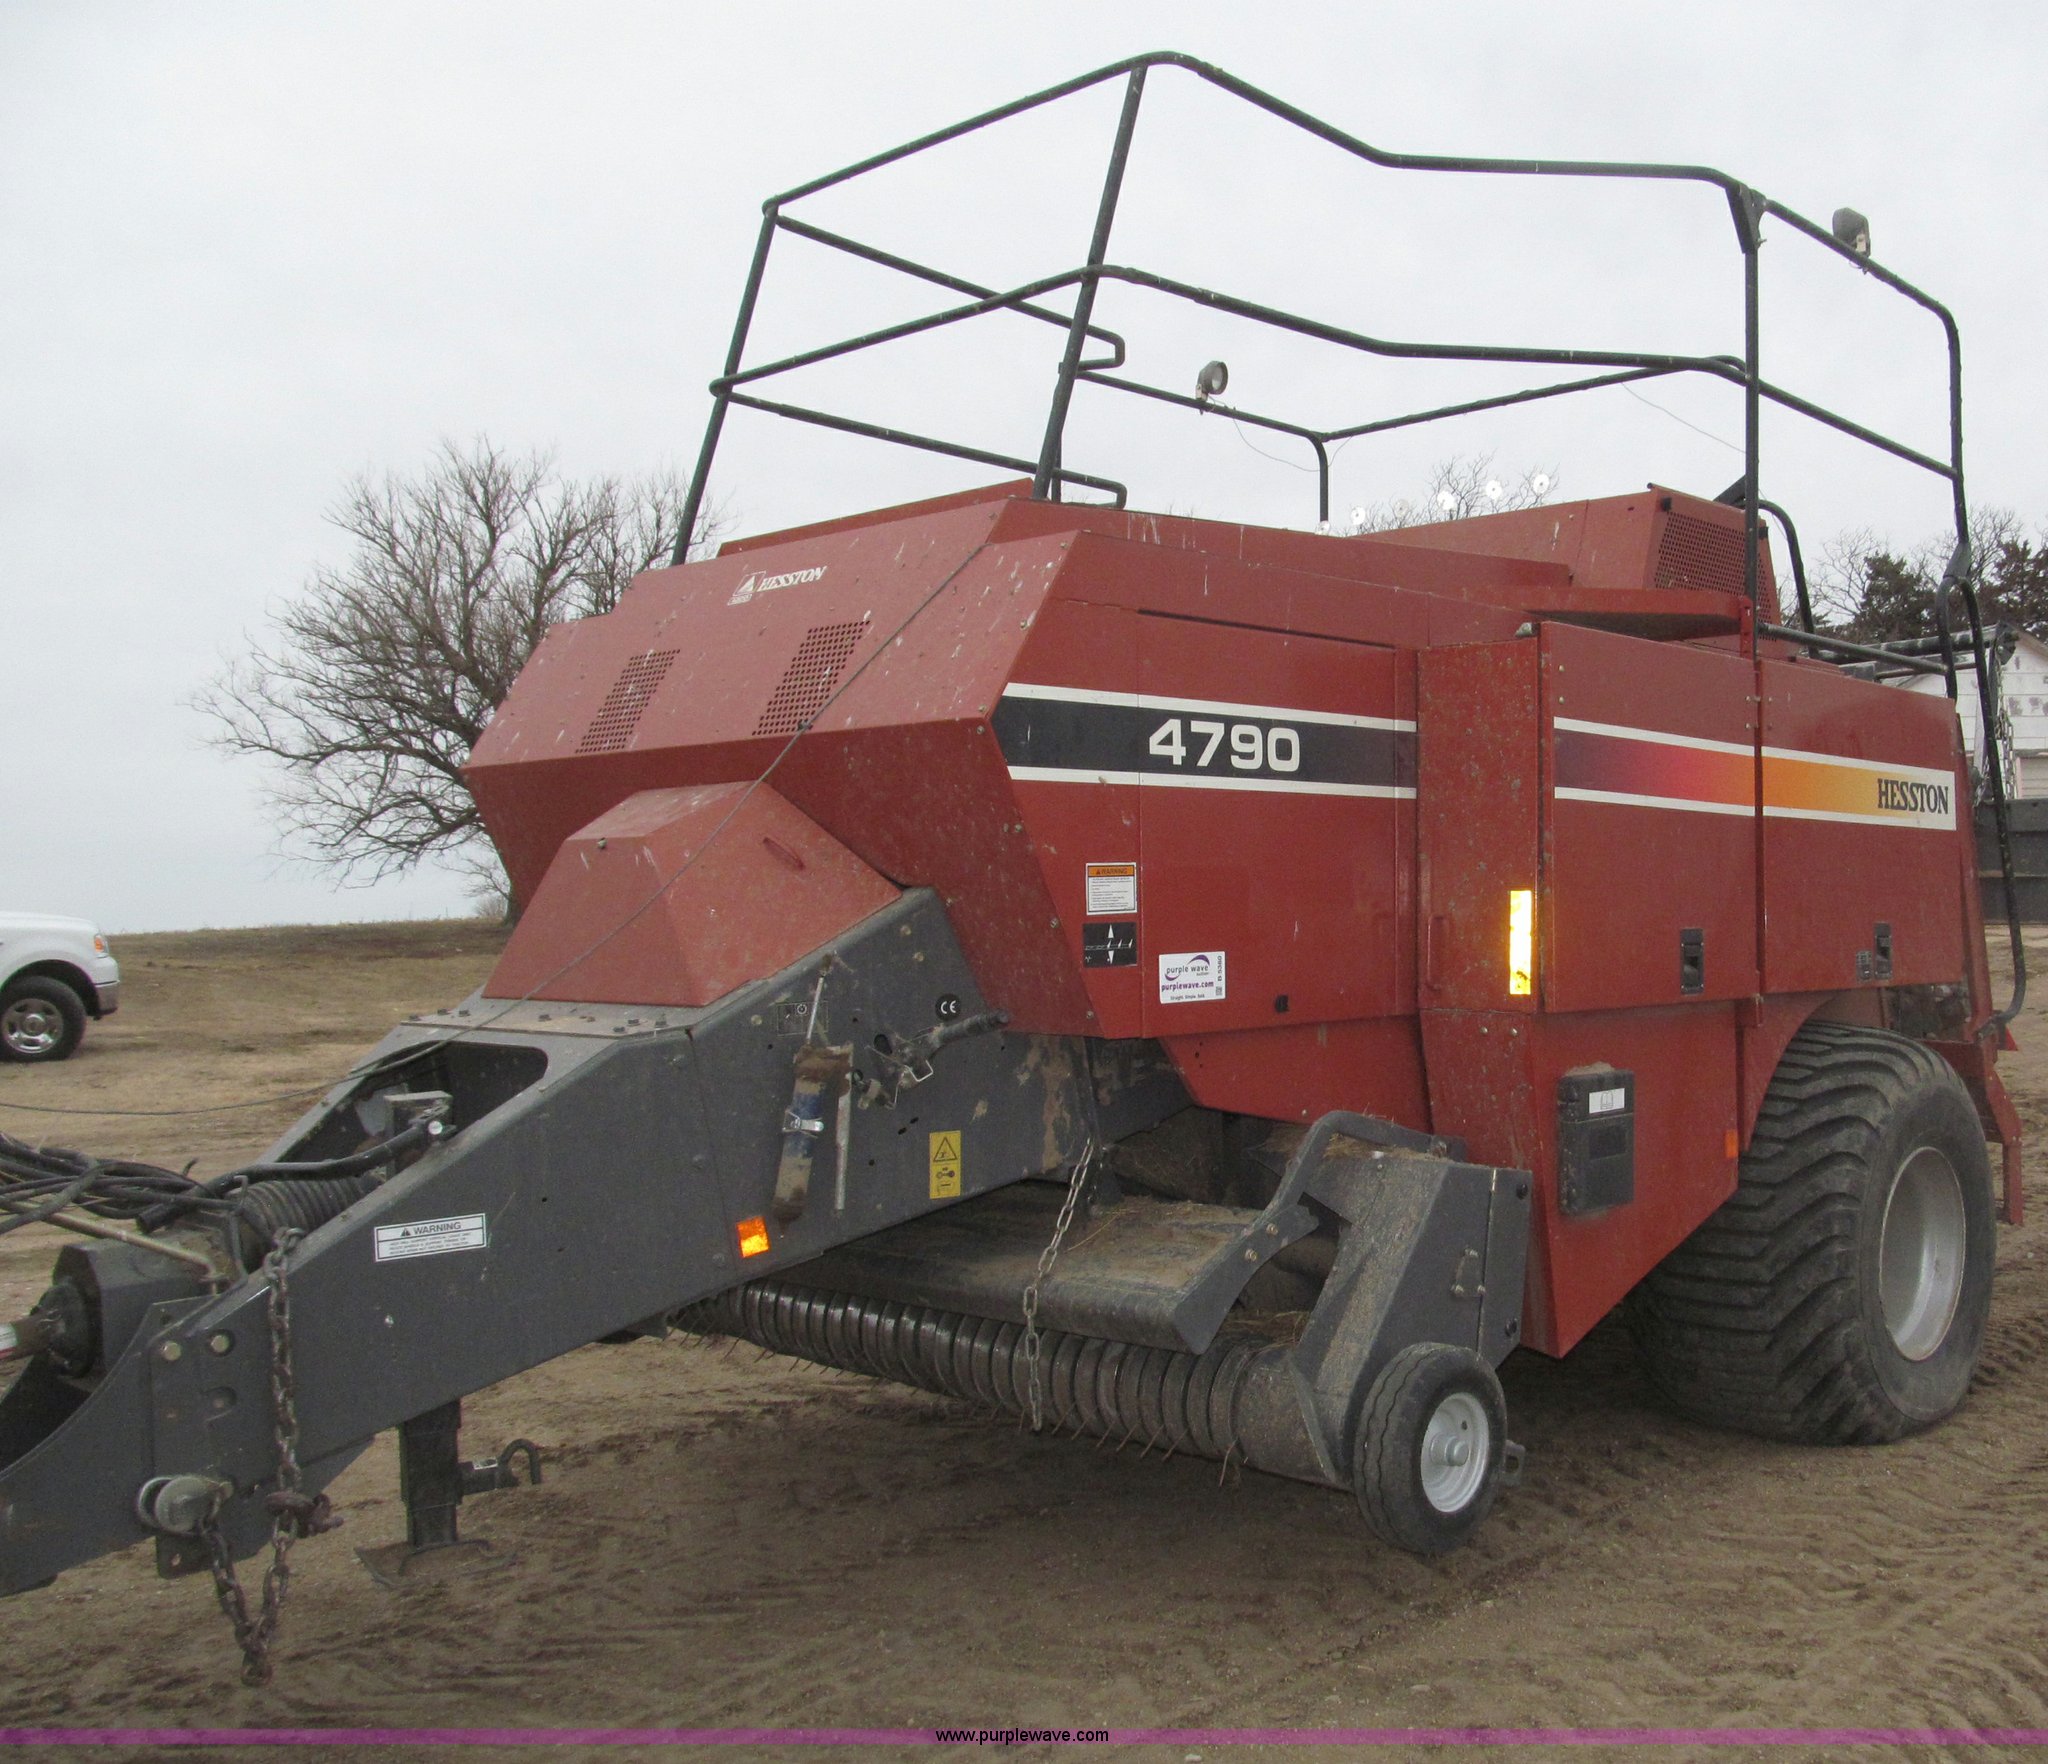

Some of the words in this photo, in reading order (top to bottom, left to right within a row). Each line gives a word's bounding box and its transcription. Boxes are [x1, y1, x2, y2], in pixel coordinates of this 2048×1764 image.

[1149, 718, 1300, 772] 4790
[1877, 778, 1949, 815] HESSTON
[1101, 867, 1128, 875] WARNING
[1166, 965, 1189, 974] purple
[1190, 964, 1209, 972] wave
[1161, 981, 1214, 992] purplewave.com
[940, 1000, 957, 1015] CE
[412, 1221, 462, 1235] WARNING
